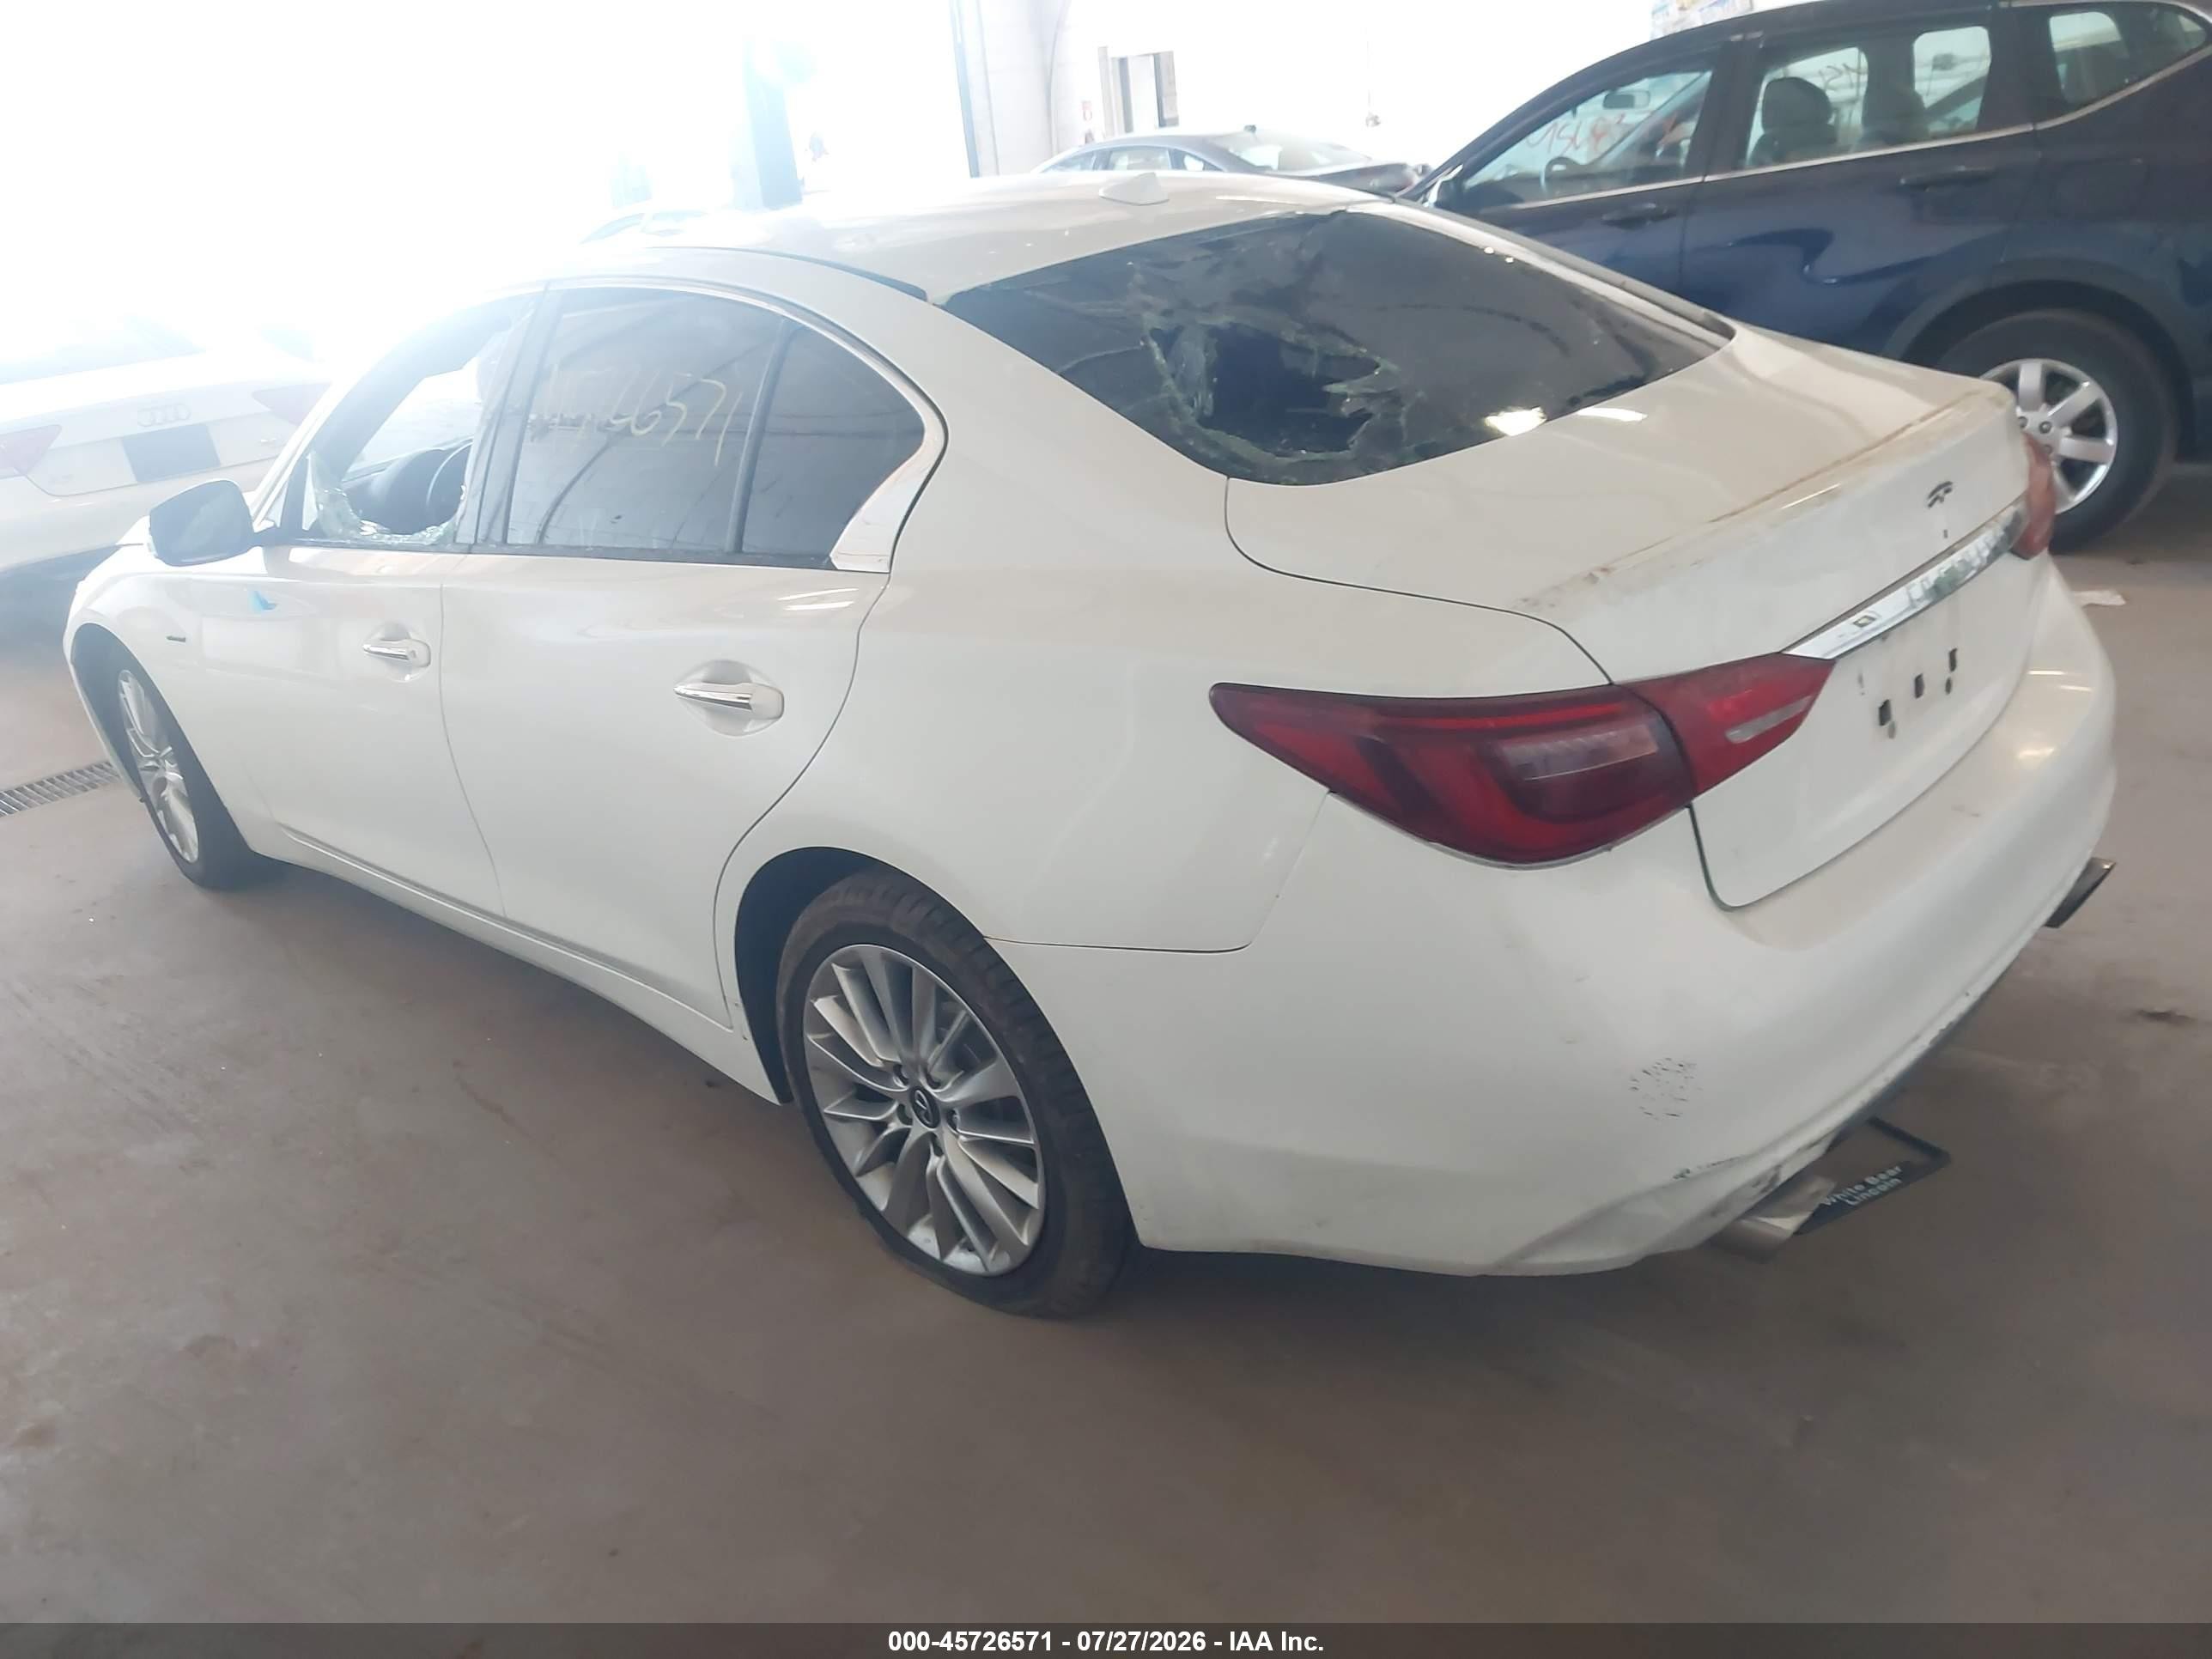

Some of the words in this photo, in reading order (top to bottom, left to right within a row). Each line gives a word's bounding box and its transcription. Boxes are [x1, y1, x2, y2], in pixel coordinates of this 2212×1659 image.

[1820, 1183, 1866, 1206] White
[1863, 1165, 1902, 1185] Bear
[1845, 1177, 1902, 1206] Lincoln
